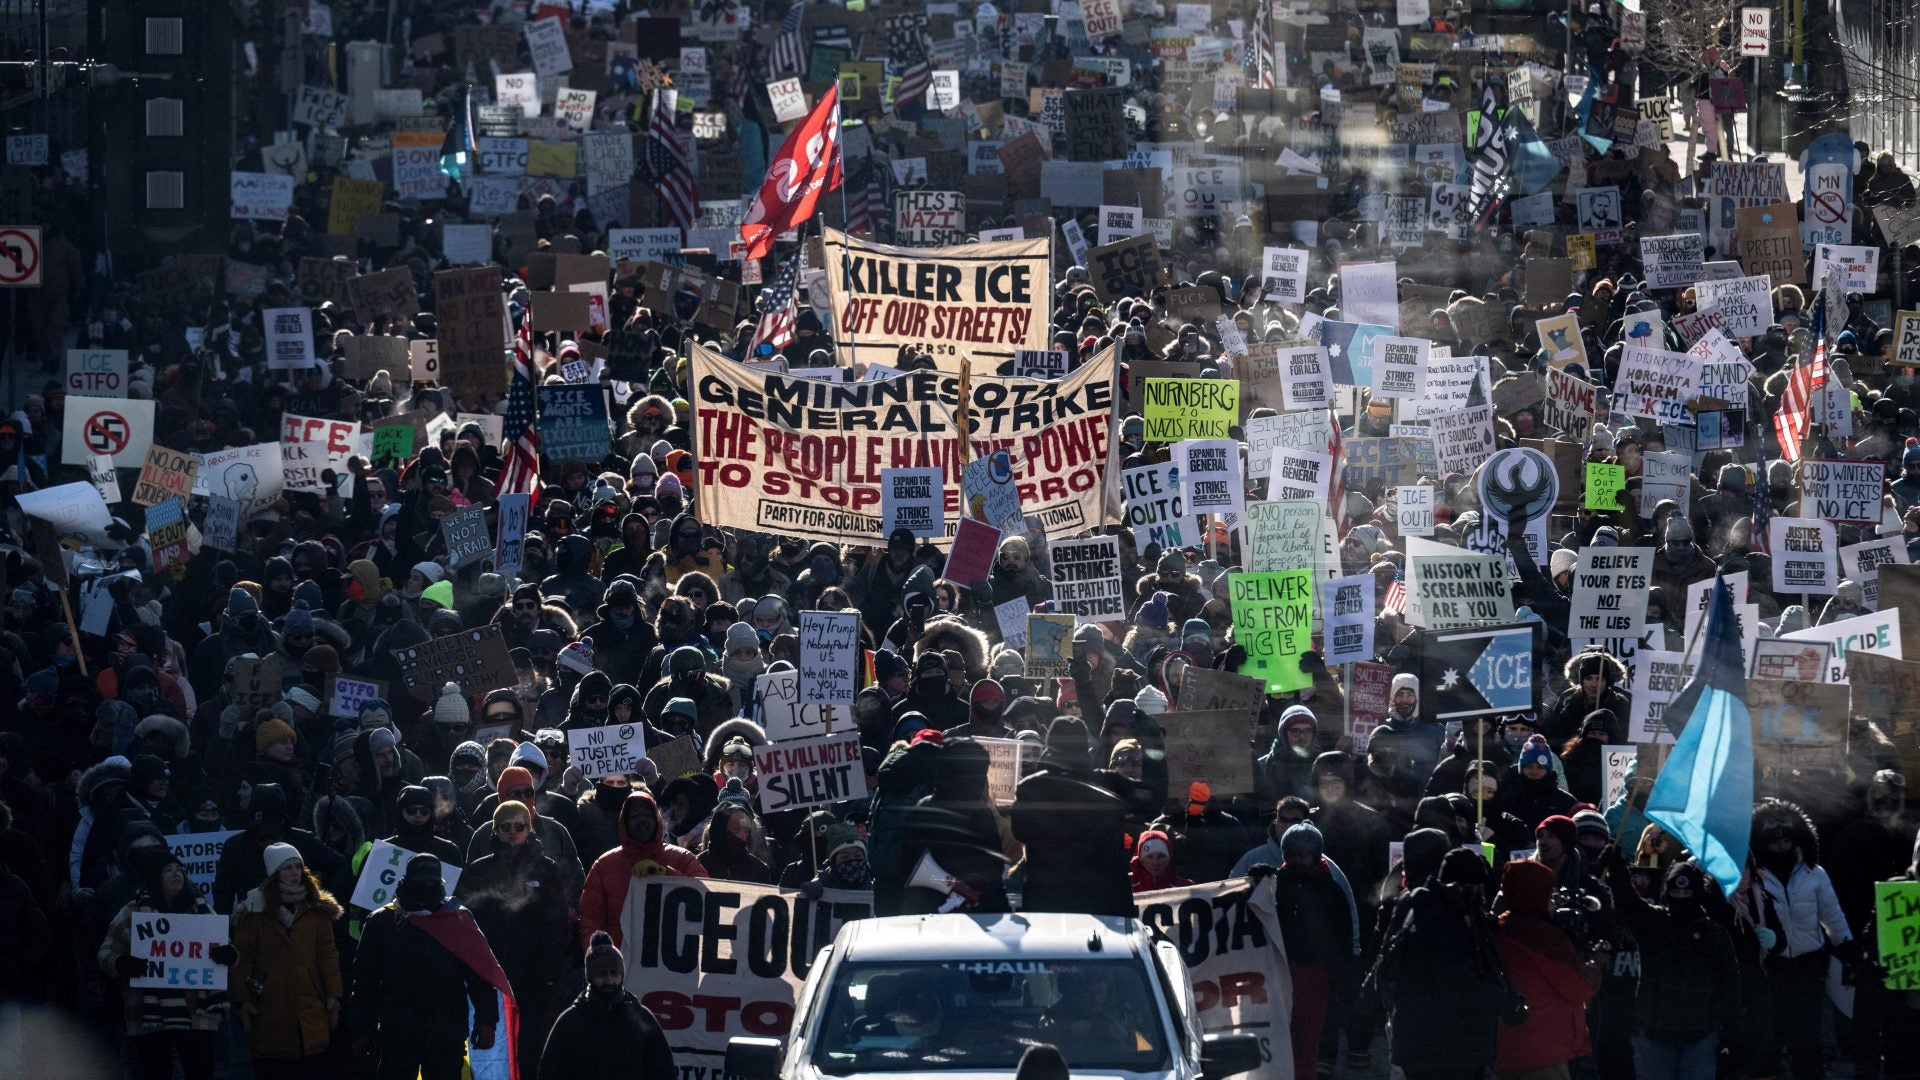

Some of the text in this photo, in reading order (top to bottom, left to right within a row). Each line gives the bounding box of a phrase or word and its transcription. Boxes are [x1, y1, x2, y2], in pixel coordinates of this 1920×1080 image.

[1084, 0, 1113, 18] ICE
[1087, 16, 1118, 33] OUT!
[1749, 14, 1763, 25] NO
[568, 92, 587, 102] NO
[694, 112, 724, 125] ICE
[1637, 101, 1670, 120] FUCK
[492, 140, 520, 150] ICE
[1186, 170, 1224, 186] ICE
[1711, 164, 1782, 180] MAKE AMERICA
[1715, 178, 1782, 197] GREAT AGAIN
[1818, 175, 1840, 189] MN
[901, 211, 956, 229] NAZI
[1107, 219, 1134, 229] GENERAL
[1746, 237, 1792, 257] PRETTI
[1096, 243, 1154, 273] ICE
[842, 254, 1030, 304] KILLER ICE
[1751, 259, 1793, 280] GOOD
[1697, 280, 1769, 299] IMMIGRANTS
[1717, 295, 1747, 308] MAKE
[842, 298, 1032, 345] OFF OUR STREETS!
[1675, 311, 1727, 340] Justice
[1385, 352, 1418, 365] GENERAL
[1386, 344, 1419, 354] EXPAND THE
[81, 354, 112, 371] ICE
[1021, 351, 1063, 368] KILLER
[1290, 353, 1319, 366] JUSTICE
[69, 373, 120, 390] GTFO
[1625, 367, 1691, 389] HORCHATA
[555, 391, 587, 402] ICE
[764, 374, 1057, 408] MINNESOTA
[1549, 370, 1596, 414] SHAME
[1630, 381, 1679, 401] WARM
[699, 375, 1112, 434] GENERAL STRIKE
[1146, 417, 1184, 438] NAZIS
[1252, 412, 1324, 433] SILENCE
[1546, 398, 1593, 439] TRUMP!
[698, 408, 758, 462] THE
[763, 427, 884, 483] PEOPLE
[1023, 414, 1112, 478] POWE
[1248, 429, 1329, 453] NEUTRALITY
[1446, 440, 1484, 457] LIKE WHEN
[207, 449, 262, 469] ABOLISH ICE
[1189, 448, 1227, 459] EXPAND THE
[1346, 439, 1397, 464] ICE
[149, 449, 198, 476] NO ONE
[1190, 458, 1228, 472] GENERAL
[1591, 465, 1617, 477] ICE
[142, 464, 186, 493] ILLEGAL
[893, 475, 931, 486] EXPAND THE
[1282, 465, 1319, 485] GENERAL
[1803, 463, 1881, 483] COLD WINTERS
[698, 461, 881, 511] TO STOP
[893, 486, 932, 499] GENERAL
[1126, 469, 1163, 499] ICE
[1194, 480, 1228, 495] STRIKE!
[1593, 479, 1613, 488] OUT
[1802, 481, 1881, 501] WARM HEARTS
[1403, 489, 1427, 504] ICE
[446, 509, 480, 528] WE ARE
[896, 506, 930, 521] STRIKE!
[1259, 506, 1316, 521] NO person
[1817, 500, 1871, 520] NO ICE
[450, 522, 479, 544] NOT
[1149, 521, 1183, 549] MN
[1785, 525, 1821, 539] JUSTICE
[449, 535, 489, 560] AFRAID
[1784, 538, 1823, 552] FOR ALEX
[1857, 546, 1894, 562] JUSTICE
[1052, 545, 1118, 565] GENERAL
[1591, 554, 1639, 569] BELIEVE
[1054, 562, 1119, 582] STRIKE:
[1422, 560, 1503, 580] HISTORY IS
[1055, 580, 1121, 600] THE PATH TO
[1235, 576, 1310, 601] DELIVER
[1423, 580, 1505, 600] SCREAMING
[1580, 573, 1646, 588] YOUR EYES
[1335, 584, 1362, 601] JUSTICE
[1597, 594, 1621, 609] NOT
[1055, 597, 1122, 617] JUSTICE
[1237, 603, 1308, 630] US FROM
[1334, 598, 1363, 617] FOR ALEX
[1432, 600, 1498, 618] ARE YOU
[802, 616, 856, 638] Hey Trump
[1579, 615, 1631, 630] THE LIES
[1243, 629, 1297, 657] ICE
[820, 652, 835, 663] US
[1486, 651, 1532, 690] ICE
[337, 681, 377, 699] GTFO
[588, 730, 606, 745] NO
[577, 743, 629, 762] JUSTICE
[756, 739, 862, 775] WE WILL NOT BE
[766, 765, 852, 811] SILENT
[136, 917, 171, 941] NO
[640, 883, 741, 975] ICE
[167, 967, 215, 986] ICE
[640, 990, 797, 1037] STO
